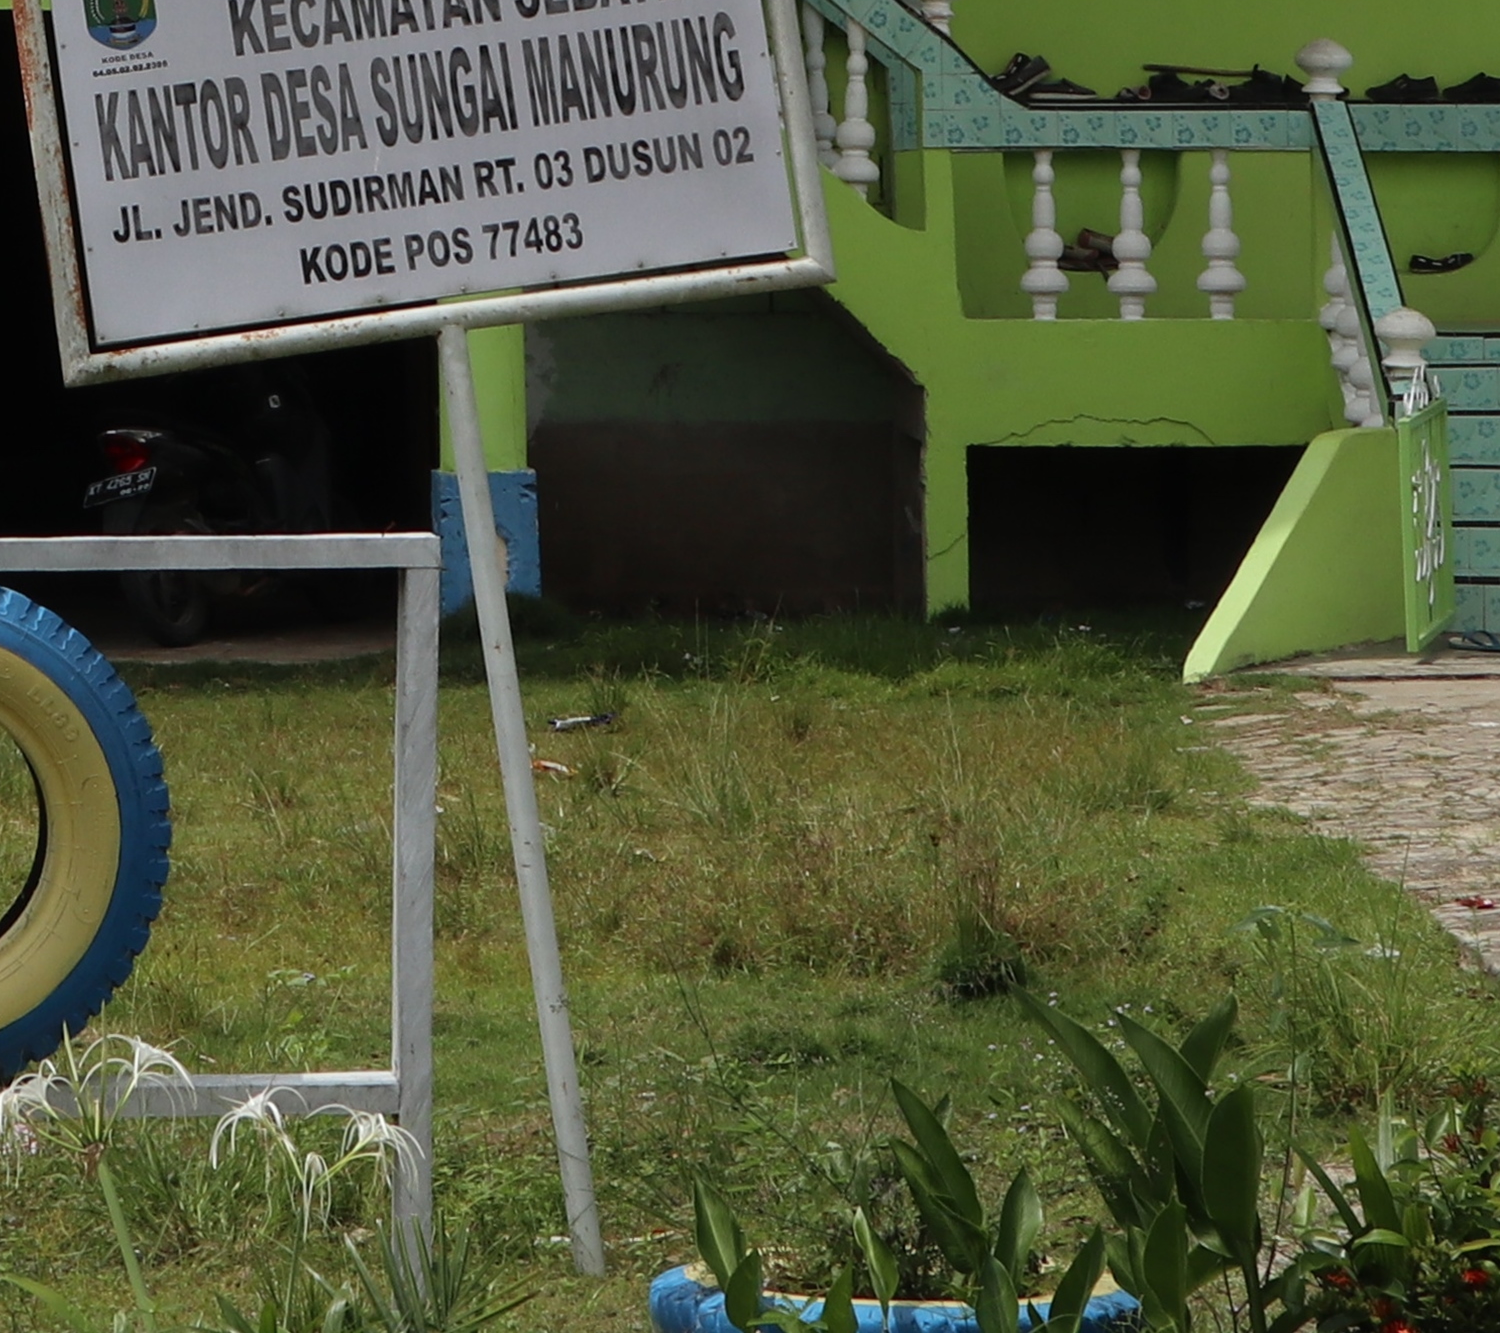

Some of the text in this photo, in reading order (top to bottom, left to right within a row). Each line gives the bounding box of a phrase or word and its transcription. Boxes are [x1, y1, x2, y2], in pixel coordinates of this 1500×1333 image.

[95, 13, 745, 182] KANTOR DESA SUNGAI MANURUNG
[101, 52, 153, 64] KODE DESA
[113, 125, 755, 245] JL. JEND. SUDIRMAN RT. 03 DUSUN 02
[301, 213, 584, 285] KODE POS 77483
